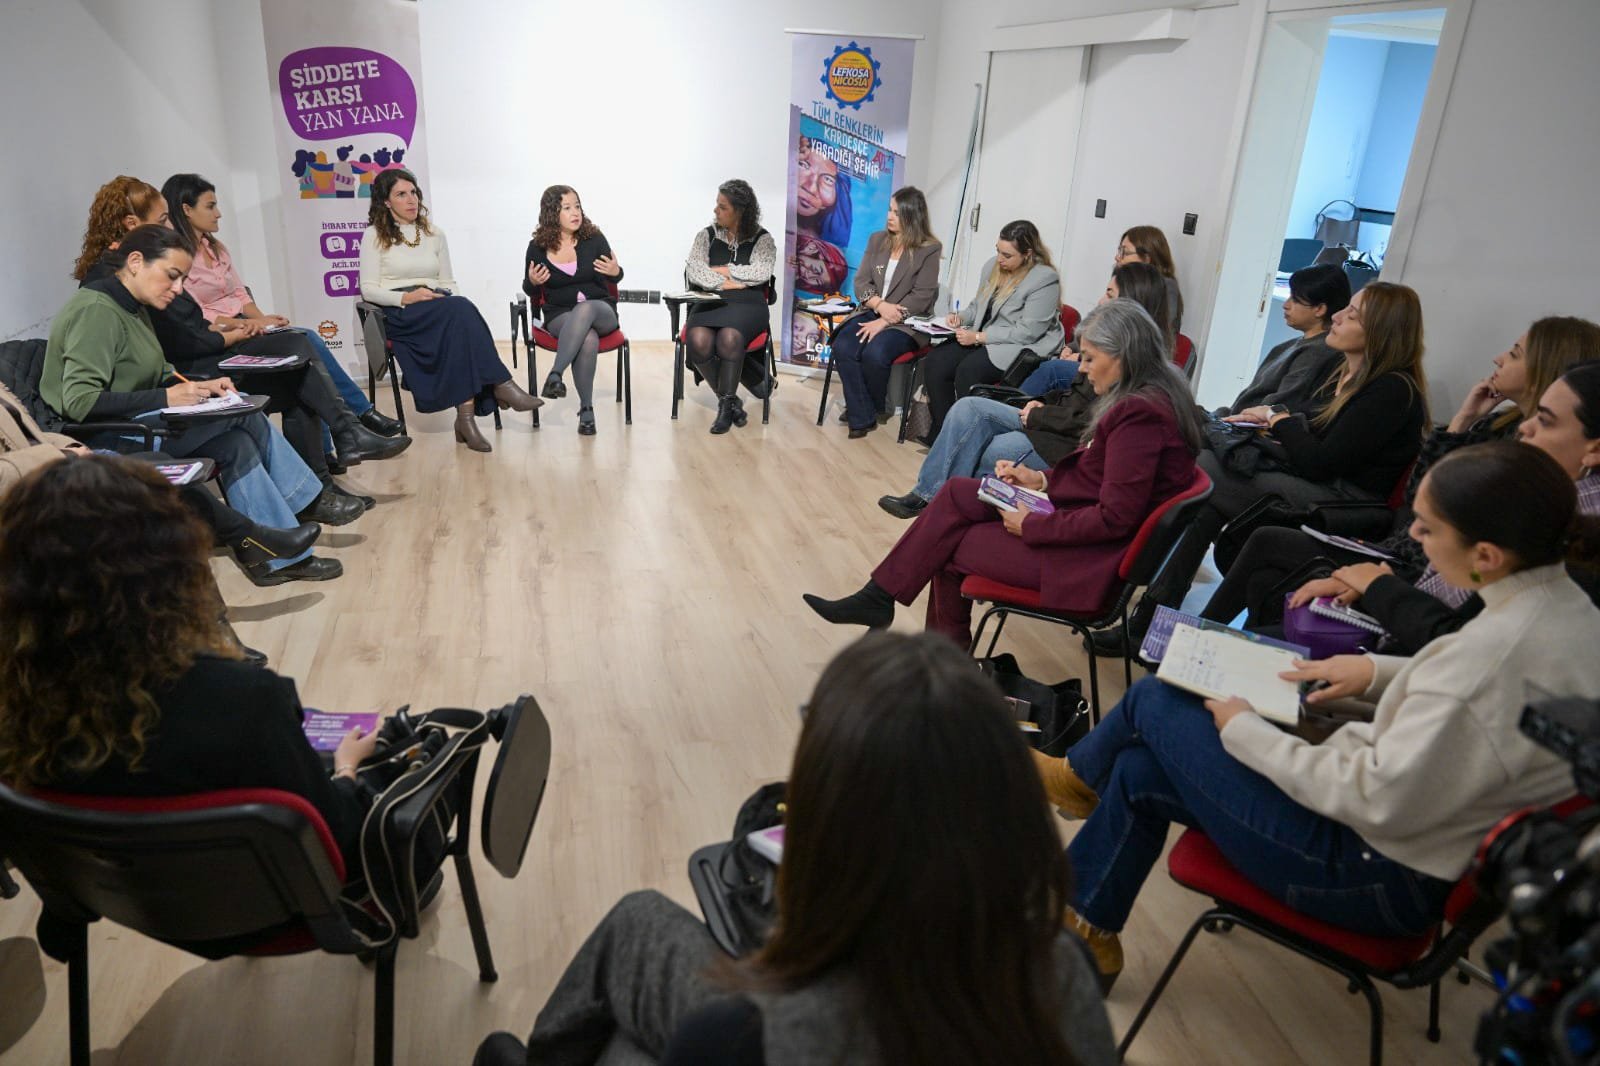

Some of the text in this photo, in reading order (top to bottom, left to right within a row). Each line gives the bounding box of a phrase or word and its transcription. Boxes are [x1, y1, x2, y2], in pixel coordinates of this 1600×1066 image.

[289, 59, 380, 88] ŞİDDETE
[293, 84, 363, 111] KARŞI
[299, 102, 404, 132] YAN YANA
[812, 101, 884, 145] TÜM RENKLERİN
